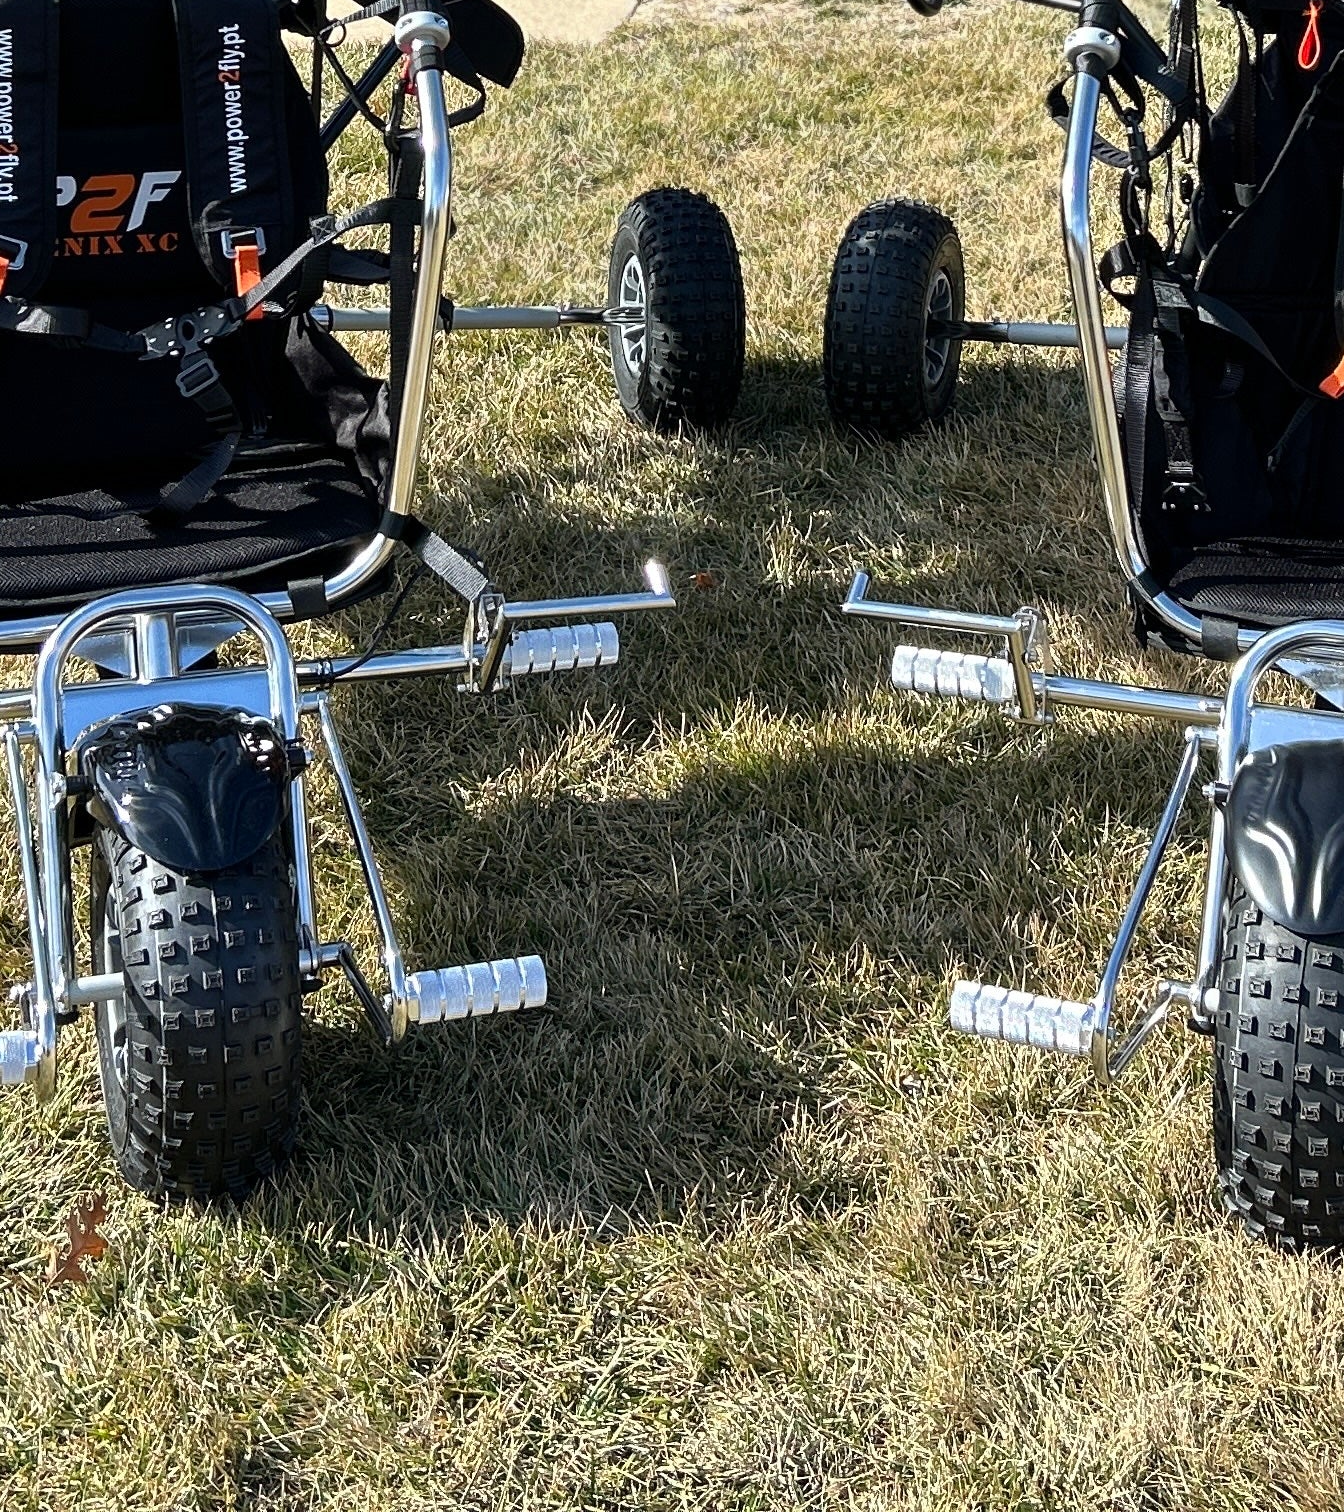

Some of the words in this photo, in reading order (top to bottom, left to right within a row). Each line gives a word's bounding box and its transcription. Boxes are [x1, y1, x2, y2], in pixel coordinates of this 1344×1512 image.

[217, 23, 250, 194] www.power2fly.pt
[54, 234, 124, 257] NIX
[136, 232, 179, 254] XC
